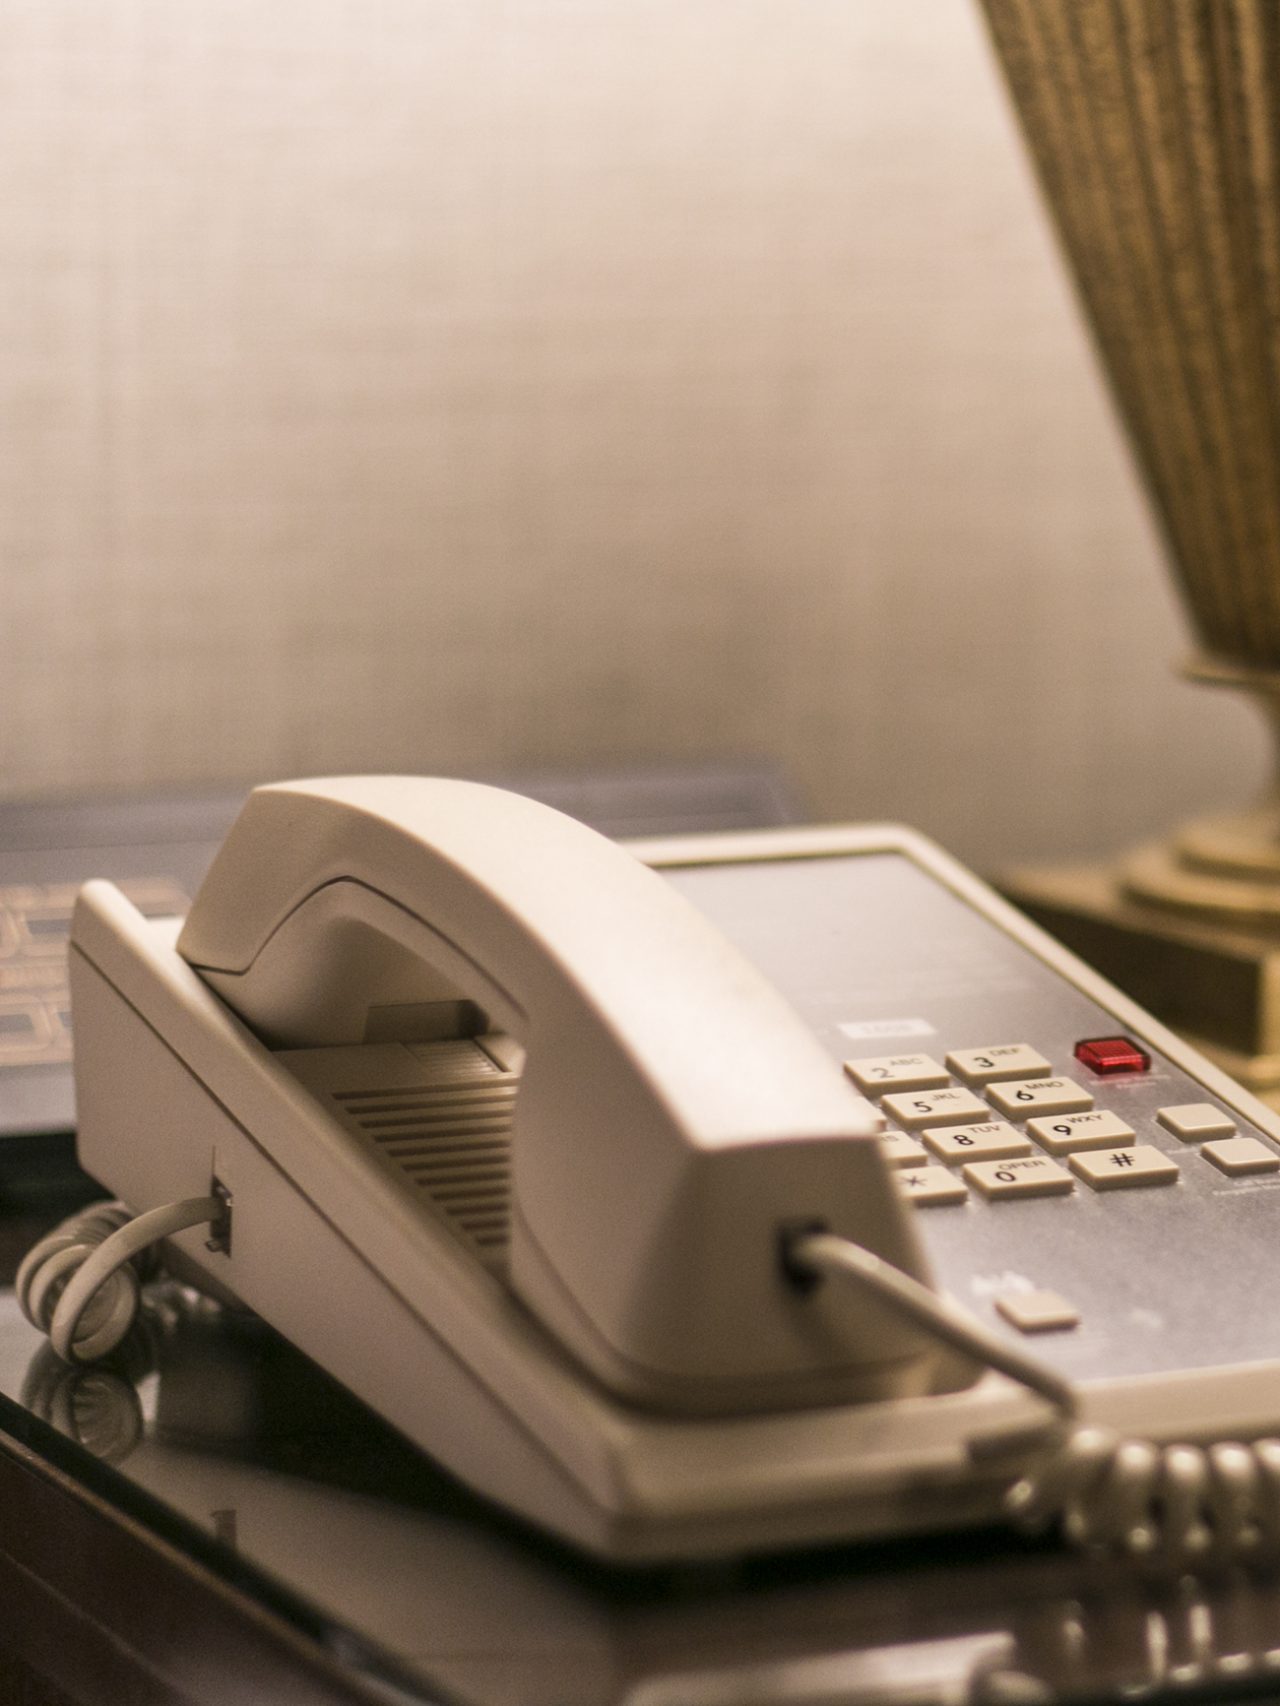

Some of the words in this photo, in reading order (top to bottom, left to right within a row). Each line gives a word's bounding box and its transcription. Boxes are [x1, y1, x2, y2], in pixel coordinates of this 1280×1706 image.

[871, 1067, 894, 1079] 2
[889, 1057, 924, 1066] ABC
[973, 1056, 995, 1068] 3
[1024, 1081, 1064, 1089] MNO
[912, 1101, 932, 1113] 5
[932, 1092, 961, 1101] JKL
[1016, 1090, 1035, 1101] 6
[1053, 1124, 1072, 1136] 9
[1066, 1114, 1103, 1123] WXY
[953, 1134, 975, 1146] 8
[967, 1125, 1001, 1133] TUV
[998, 1159, 1046, 1170] OPER
[1110, 1152, 1135, 1168] #
[994, 1170, 1017, 1183] 0
